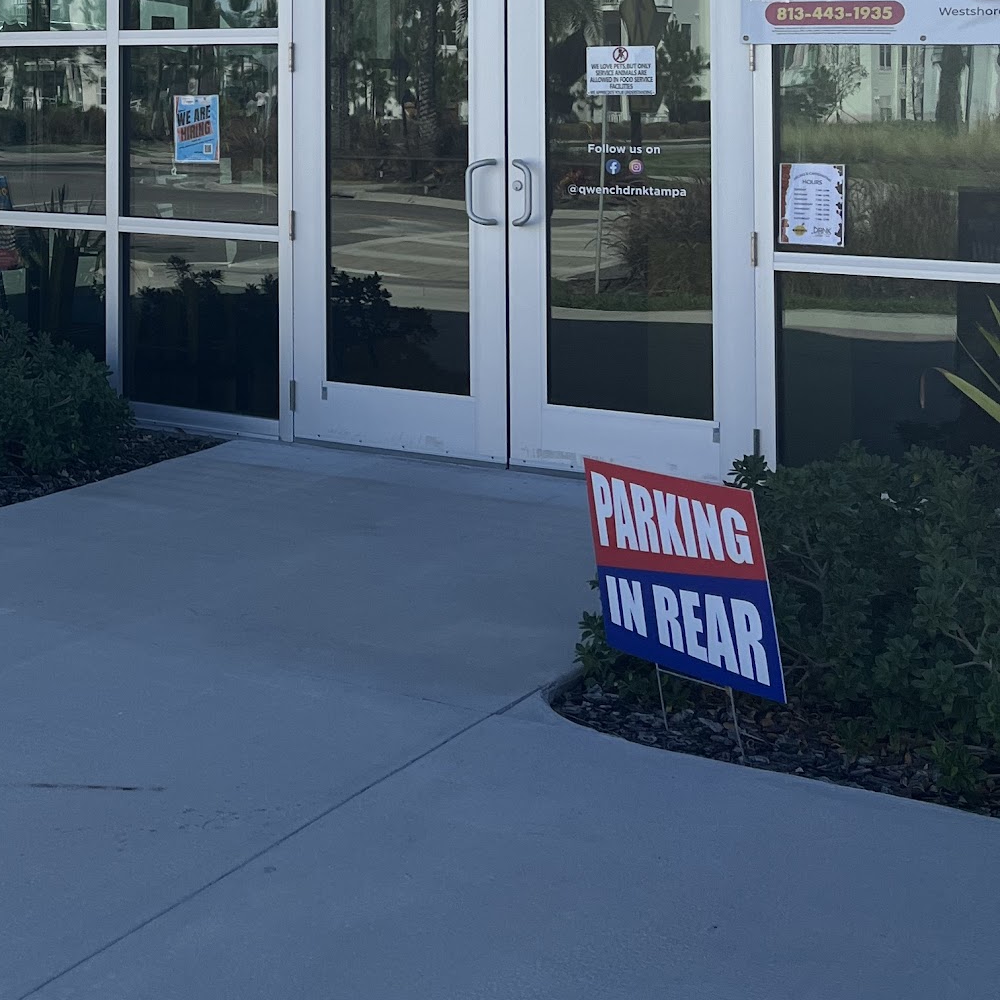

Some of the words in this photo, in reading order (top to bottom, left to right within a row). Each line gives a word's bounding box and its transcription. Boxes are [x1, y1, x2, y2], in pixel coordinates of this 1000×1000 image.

[776, 6, 893, 20] 813-443-1935
[938, 6, 1000, 16] Westshor
[177, 110, 191, 127] WE
[194, 105, 211, 122] ARE
[180, 120, 211, 141] HIRING
[588, 143, 625, 154] Follow
[630, 146, 642, 154] us
[646, 146, 660, 154] on
[567, 184, 687, 197] @qwenchdrnktampa
[590, 470, 754, 565] PARKING
[605, 574, 648, 638] IN
[652, 584, 770, 687] REAR
